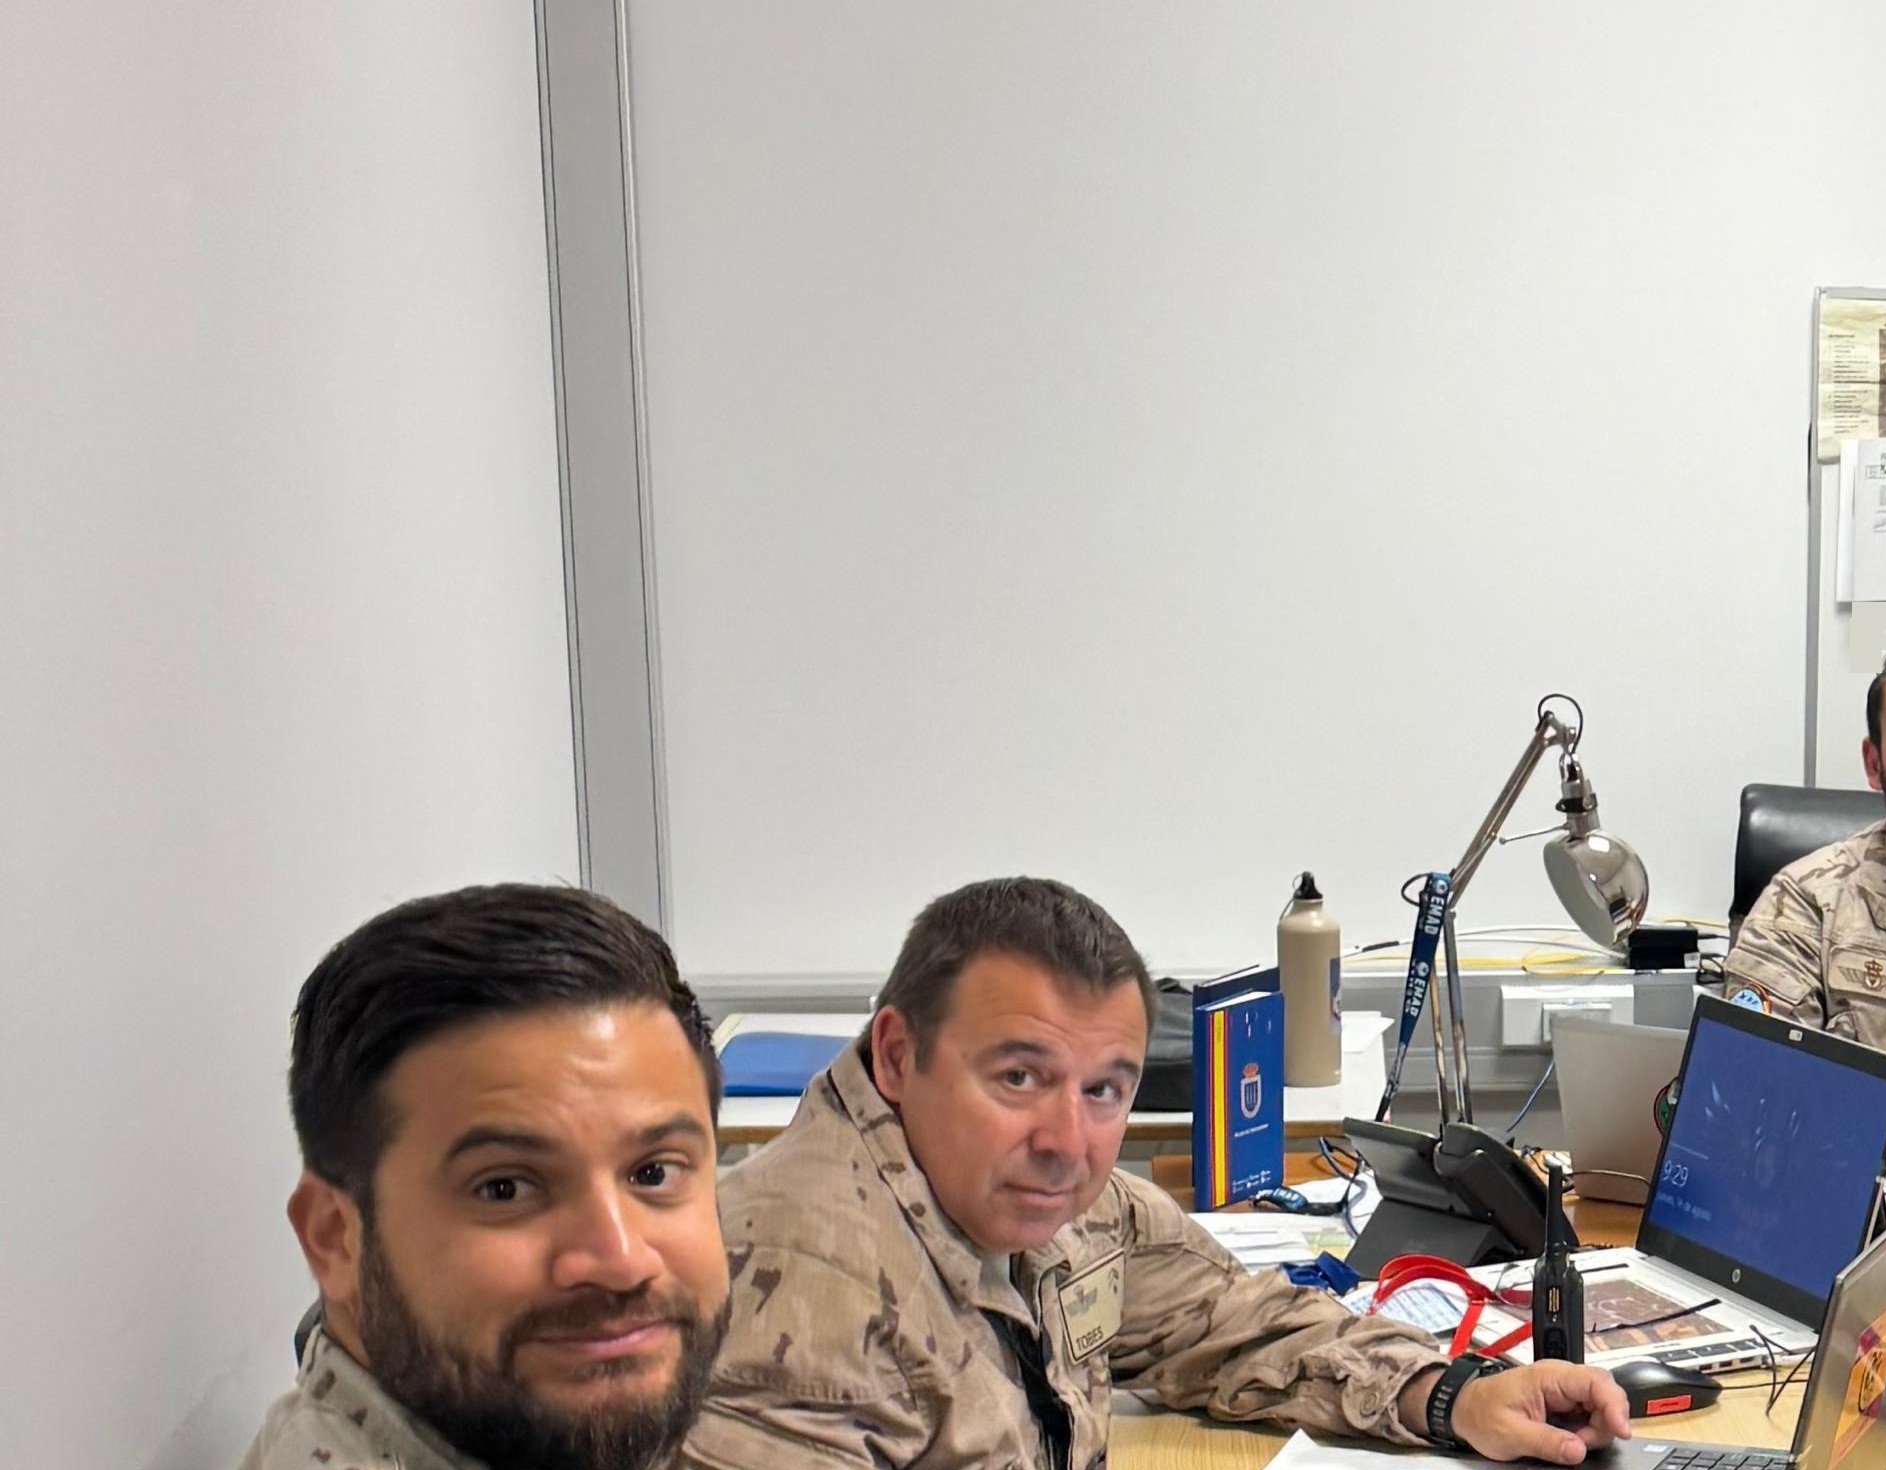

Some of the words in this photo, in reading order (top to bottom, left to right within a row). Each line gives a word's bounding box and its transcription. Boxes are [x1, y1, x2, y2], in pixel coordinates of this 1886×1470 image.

[1423, 895, 1445, 935] EMAD
[1410, 977, 1426, 1017] EMAD
[1662, 1158, 1689, 1189] 9:29
